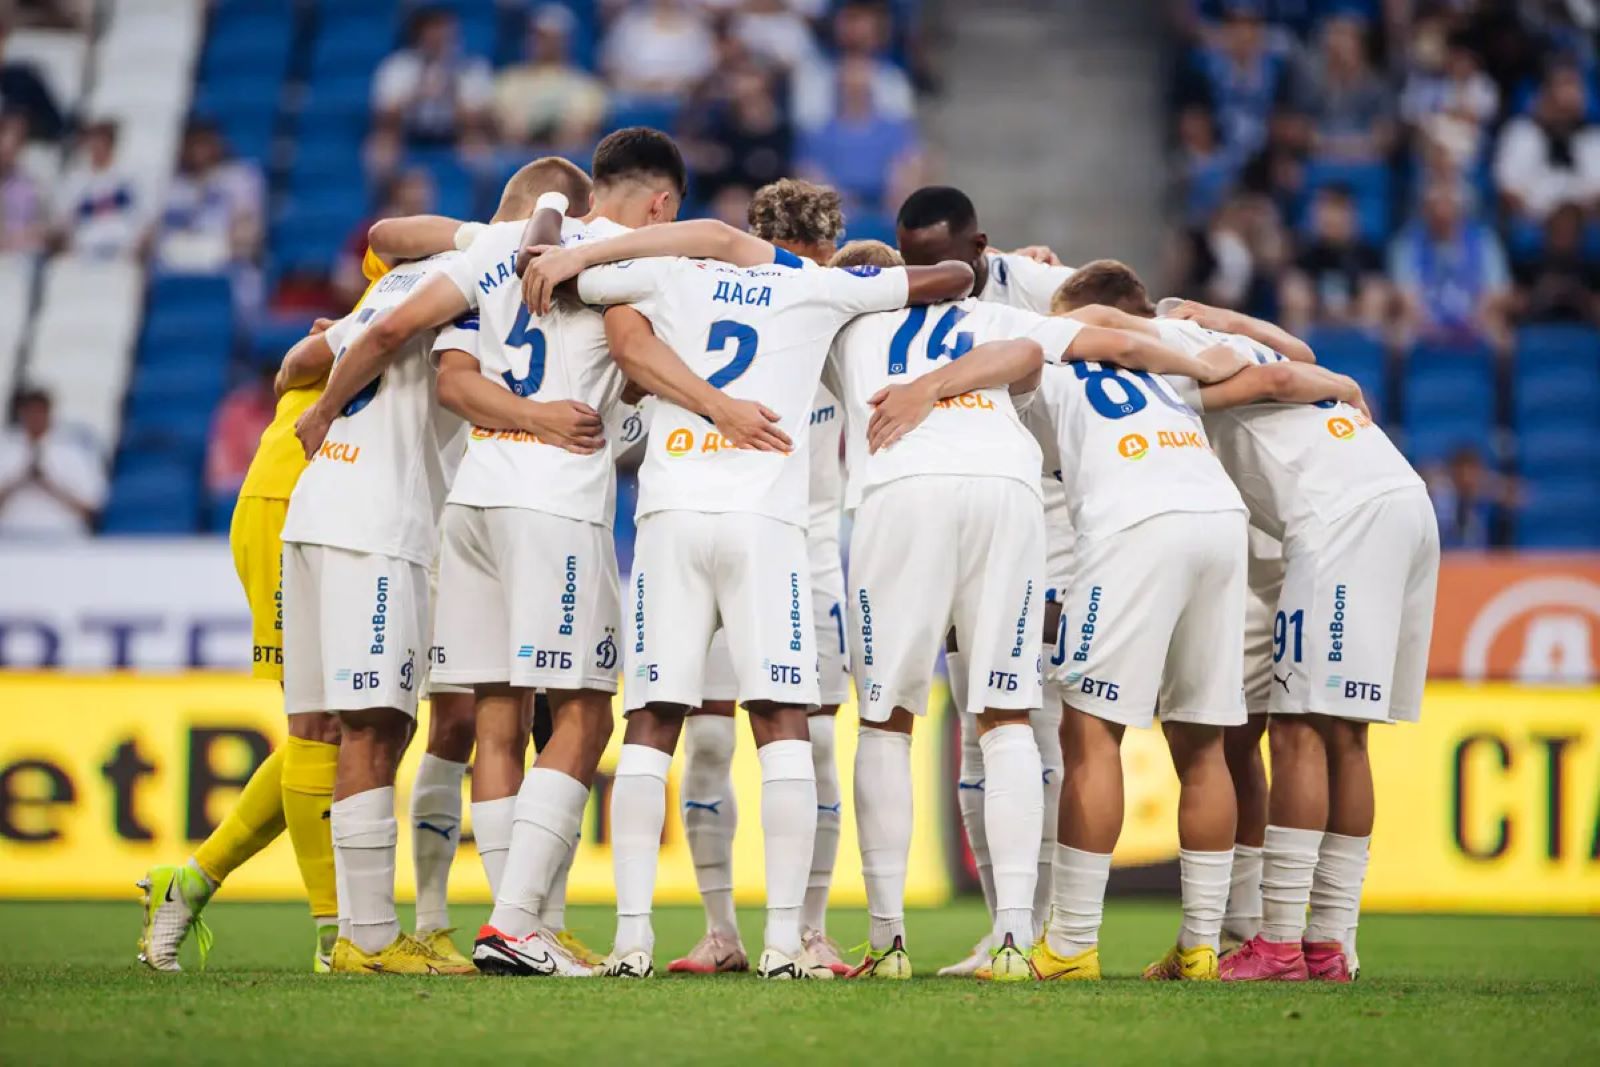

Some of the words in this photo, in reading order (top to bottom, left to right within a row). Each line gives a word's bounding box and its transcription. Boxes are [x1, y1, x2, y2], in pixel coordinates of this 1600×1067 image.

[712, 279, 772, 307] ДАСА
[501, 301, 547, 397] 5
[703, 319, 759, 405] 2
[370, 576, 388, 655] BetBoom
[558, 555, 577, 636] BetBoom
[635, 572, 645, 654] BetBoom
[789, 572, 802, 652] BetBoom
[859, 588, 874, 666] BetBoom
[1011, 580, 1033, 658] BetBoom
[1073, 586, 1103, 662] BetBoom
[1328, 584, 1347, 662] BetBoom
[252, 645, 284, 665] ВТБ
[535, 650, 573, 670] ВТБ
[771, 664, 802, 685] ВТБ
[1272, 608, 1305, 664] 91
[353, 671, 380, 690] ВТБ
[1080, 676, 1120, 701] ВТБ
[1344, 680, 1382, 701] ВТБ
[1451, 732, 1600, 862] СТ
